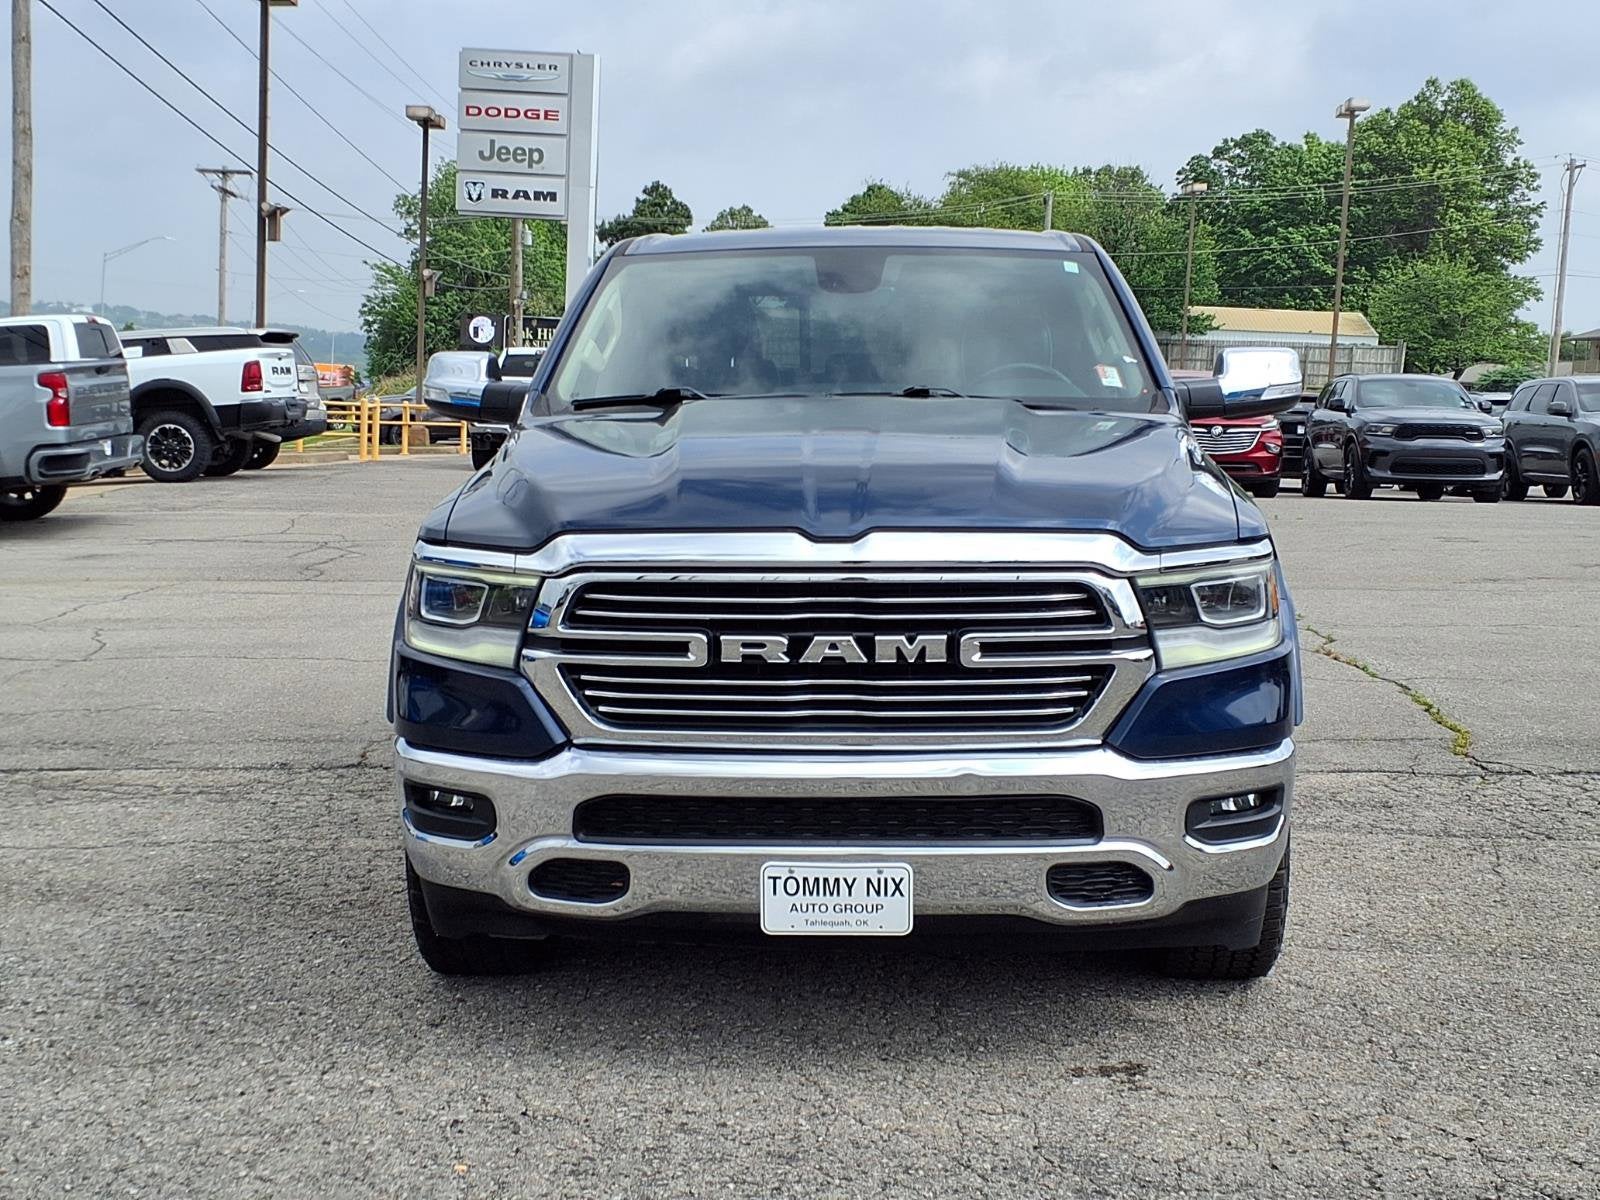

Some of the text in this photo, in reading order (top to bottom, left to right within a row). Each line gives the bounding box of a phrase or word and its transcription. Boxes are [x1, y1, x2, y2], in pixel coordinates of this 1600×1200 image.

[468, 59, 558, 71] CHRYSLER
[465, 105, 560, 121] DODGE
[478, 139, 544, 169] Jeep
[491, 188, 557, 203] RAM
[271, 366, 291, 375] RAM
[720, 634, 948, 663] RAM
[767, 875, 905, 897] TOMMY NIX
[789, 903, 884, 914] AUTO GROUP
[804, 918, 869, 929] Tahlequah, OK
